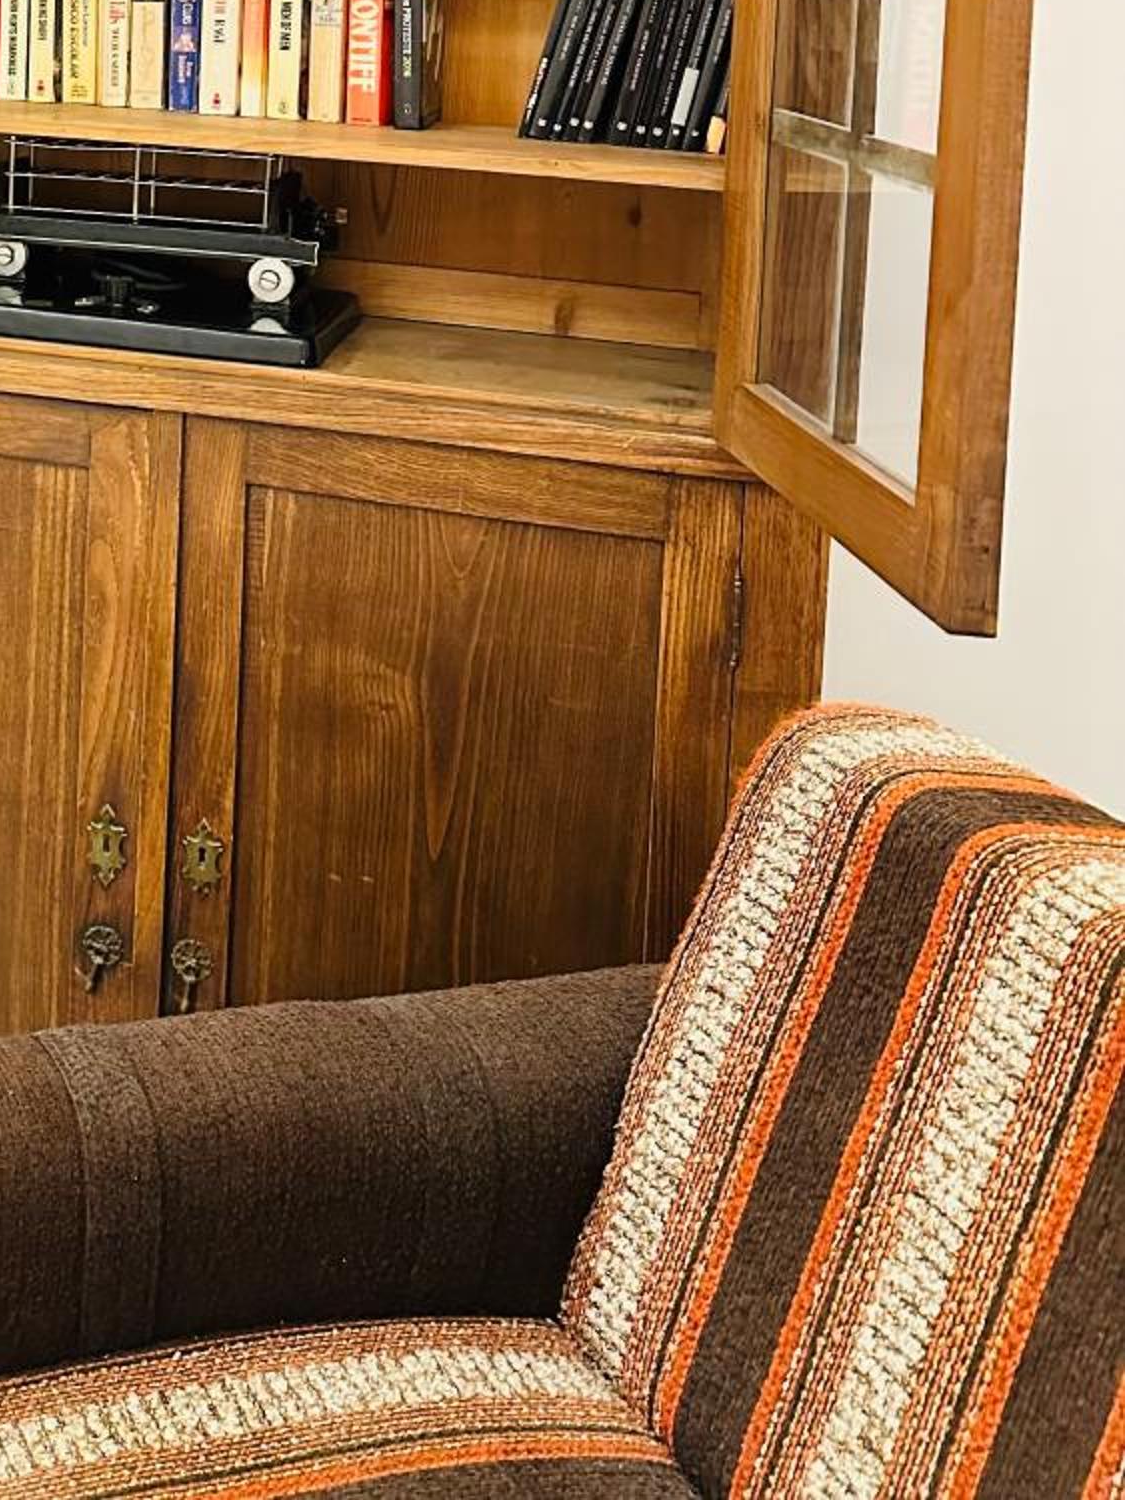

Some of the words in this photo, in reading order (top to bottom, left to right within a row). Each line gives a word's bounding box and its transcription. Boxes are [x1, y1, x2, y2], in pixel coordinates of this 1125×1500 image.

[281, 1, 293, 20] MEN
[280, 22, 291, 31] OF
[279, 32, 291, 51] MEN
